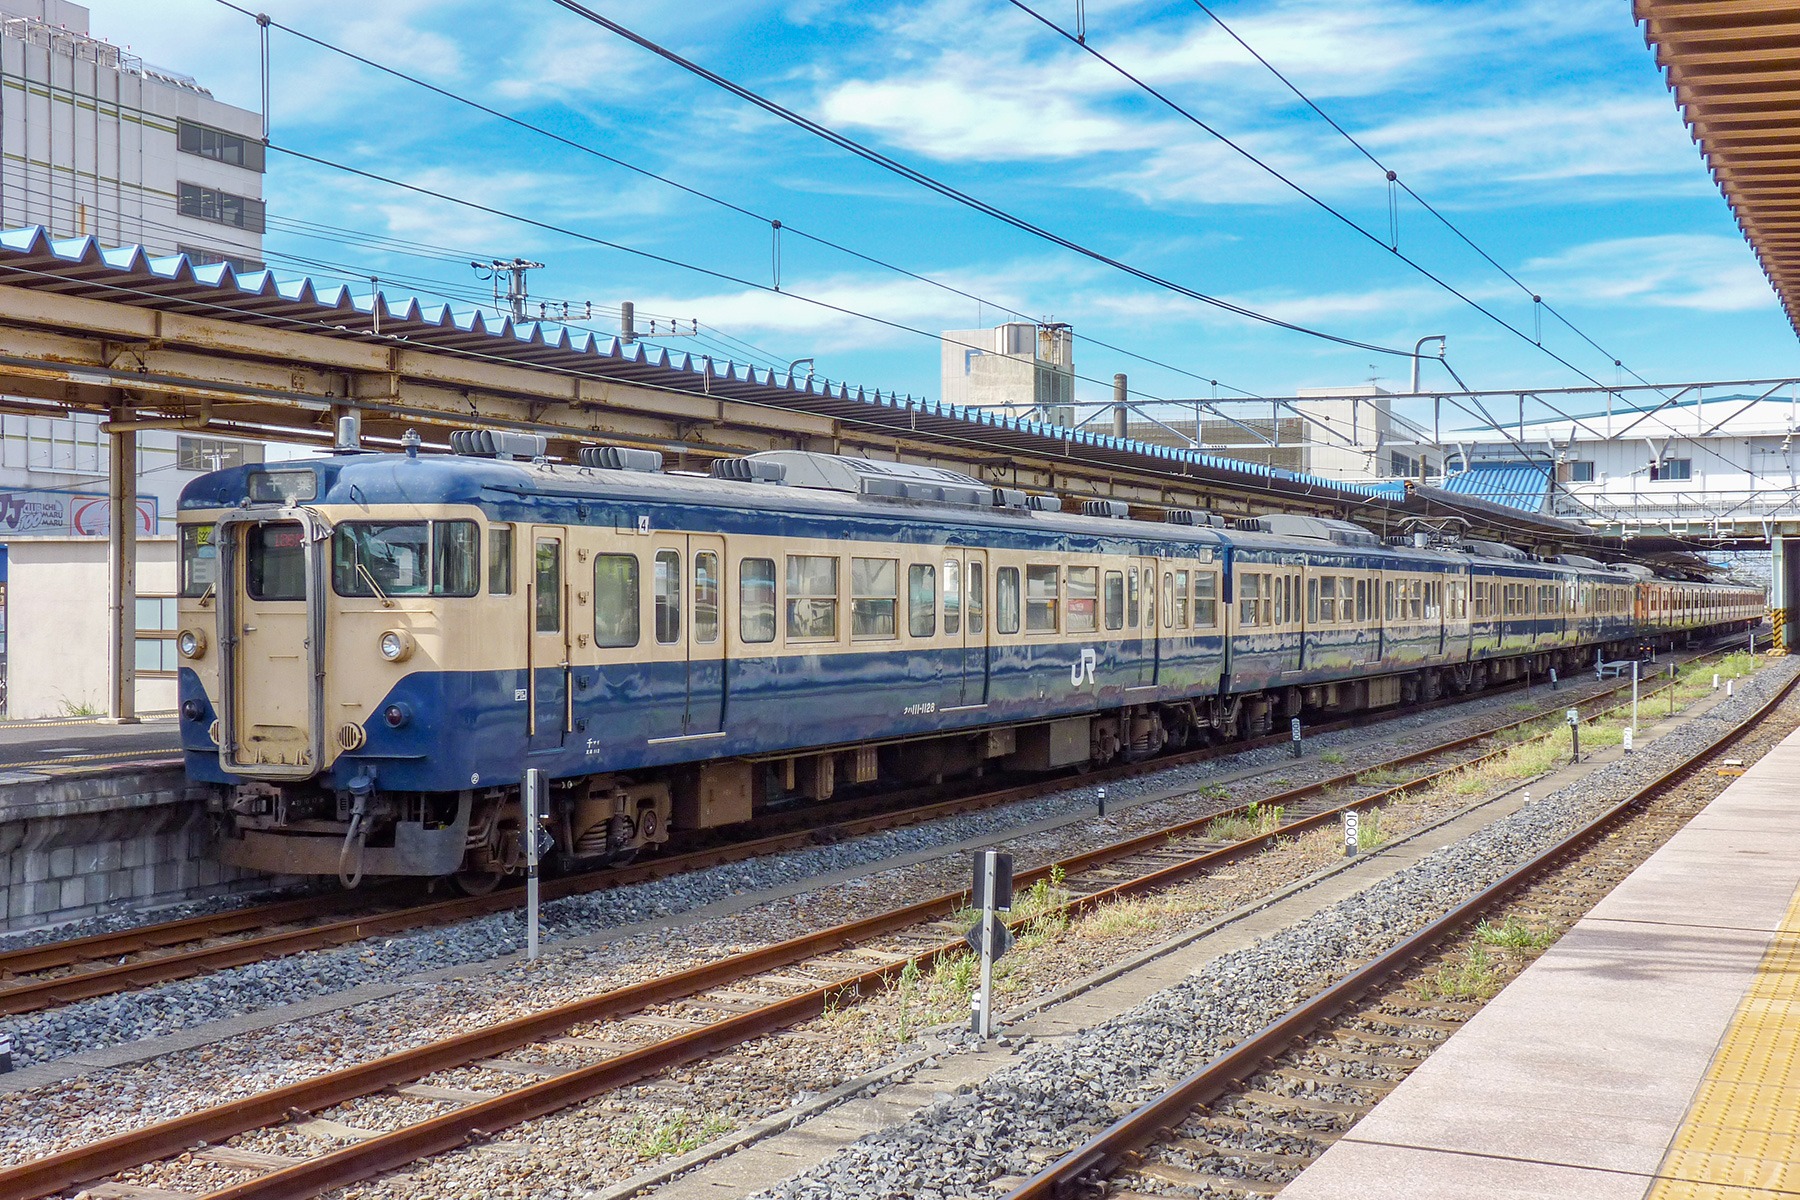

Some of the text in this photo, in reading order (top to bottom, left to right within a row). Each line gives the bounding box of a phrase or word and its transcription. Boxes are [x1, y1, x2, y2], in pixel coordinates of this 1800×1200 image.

[266, 476, 312, 492] 千葉
[18, 513, 42, 531] 100
[1071, 649, 1096, 686] JR
[1346, 815, 1357, 845] 1000
